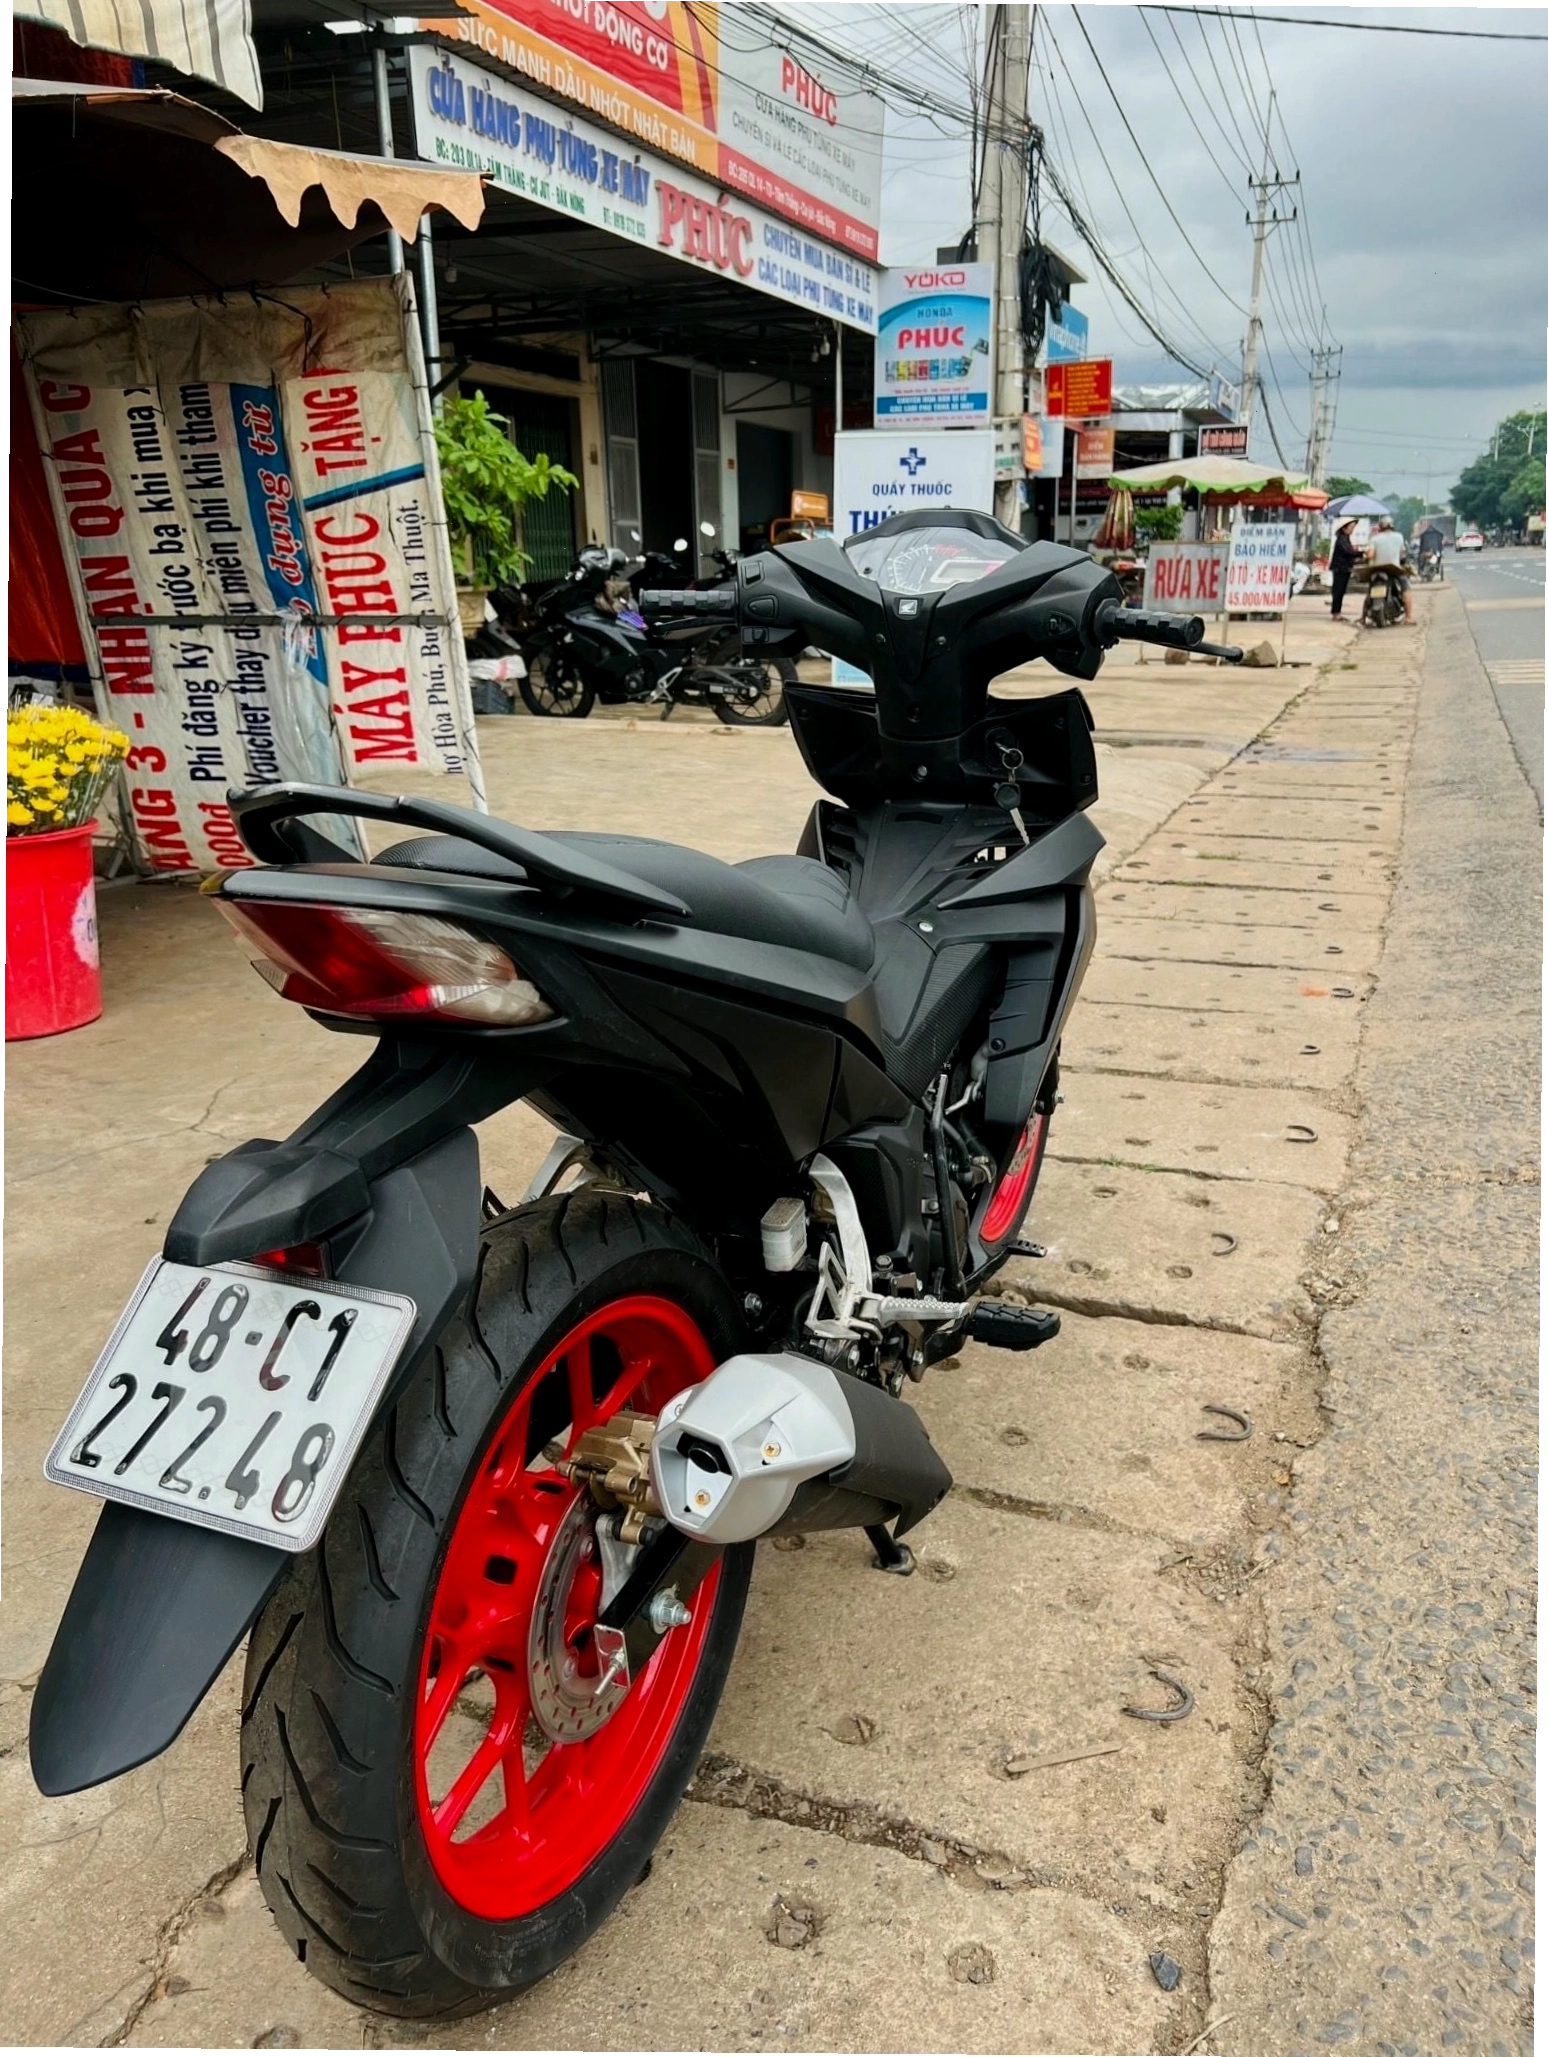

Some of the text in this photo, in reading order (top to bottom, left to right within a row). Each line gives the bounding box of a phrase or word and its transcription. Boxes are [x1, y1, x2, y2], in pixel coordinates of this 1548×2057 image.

[594, 2, 643, 56] ĐỘNG
[646, 36, 668, 70] CƠ
[782, 56, 837, 127] PHÚC
[427, 54, 466, 126] CỬA
[468, 78, 521, 150] HÀNG
[599, 147, 618, 195] XE
[620, 155, 650, 207] MÁY
[655, 179, 754, 277] PHÚC
[904, 271, 965, 289] YOKO
[898, 320, 965, 350] PHÚC
[127, 405, 163, 462] mua
[176, 383, 217, 445] tham
[243, 401, 278, 456] từ
[300, 385, 381, 478] TẶNG
[130, 472, 176, 513] khi
[179, 452, 224, 490] khi
[189, 498, 242, 533] phí
[258, 469, 304, 586] dụng
[149, 524, 187, 554] bạ
[409, 571, 432, 602] Ma
[1196, 558, 1221, 599] XE
[1256, 566, 1268, 585] XE
[224, 602, 261, 640] du
[169, 641, 214, 669] ký
[226, 649, 270, 694] thay
[181, 679, 219, 737] đăng
[333, 660, 417, 763] MÁY
[431, 712, 457, 748] Hòa
[126, 745, 167, 773] 3
[187, 745, 227, 781] Phí
[236, 702, 283, 786] Voucher
[156, 1277, 358, 1402] 48-C1
[70, 1373, 335, 1523] 272.48
